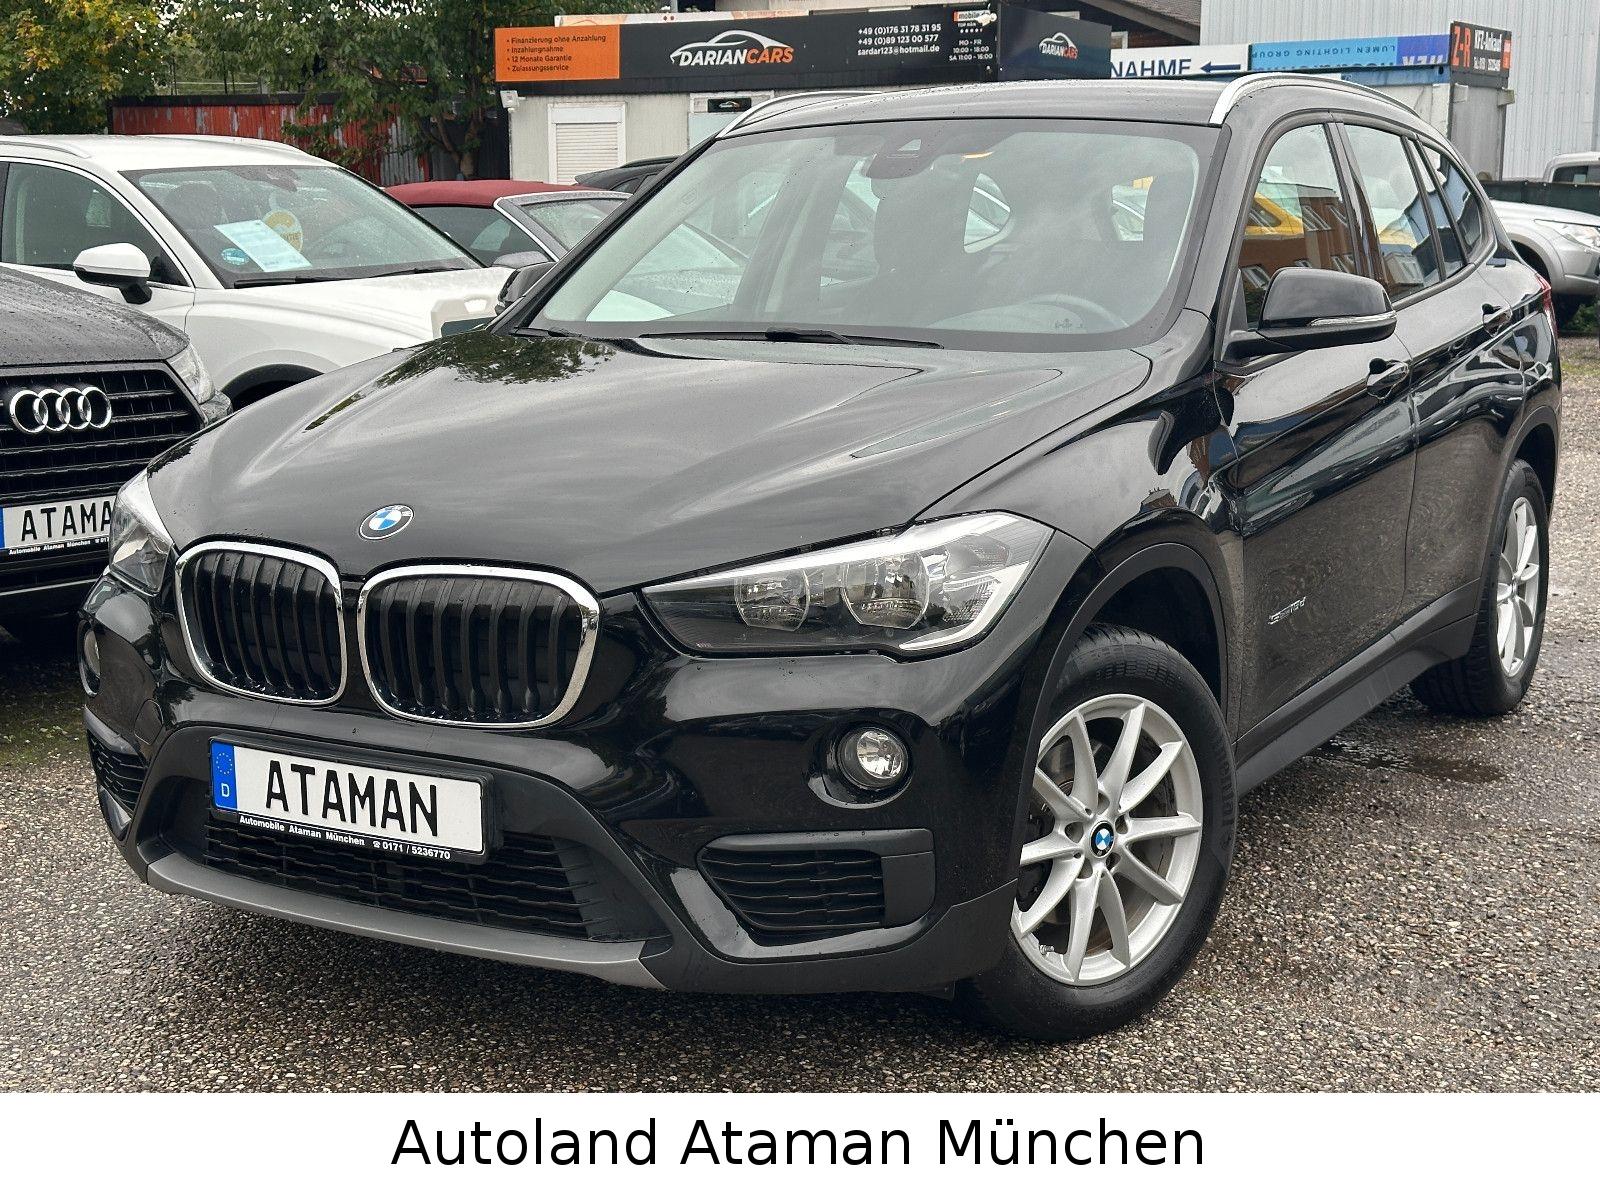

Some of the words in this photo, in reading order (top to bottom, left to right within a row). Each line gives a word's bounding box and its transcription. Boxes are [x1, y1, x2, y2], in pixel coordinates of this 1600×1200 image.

[858, 27, 873, 35] +49
[874, 26, 899, 36] (0)176
[900, 25, 909, 33] 31
[910, 25, 920, 33] 78
[921, 24, 930, 32] 31
[931, 23, 942, 32] 95
[511, 36, 553, 44] Finanzierung
[572, 34, 607, 43] Anzahlung
[858, 37, 873, 46] +49
[874, 36, 896, 46] (0)89
[897, 35, 910, 43] 123
[911, 34, 923, 43] 00
[924, 33, 939, 42] 577
[511, 45, 564, 54] Inzahlungnahme
[857, 44, 940, 56] sardar123@hotmail.de
[1041, 43, 1078, 60] DARIANCARS
[1296, 47, 1350, 56] LIGHTING
[1357, 45, 1396, 54] LUMEN
[520, 55, 544, 63] Monate
[544, 54, 573, 62] Garantie
[679, 47, 795, 66] DARIANCARS
[512, 64, 569, 73] Zulassungsservice
[8, 546, 41, 555] Automobile
[220, 783, 230, 798] D
[265, 759, 438, 837] ATAMAN
[239, 815, 285, 832] Automobile
[288, 824, 322, 839] Ataman
[325, 831, 365, 846] München
[382, 839, 403, 852] 0171
[411, 844, 451, 860] 5236770
